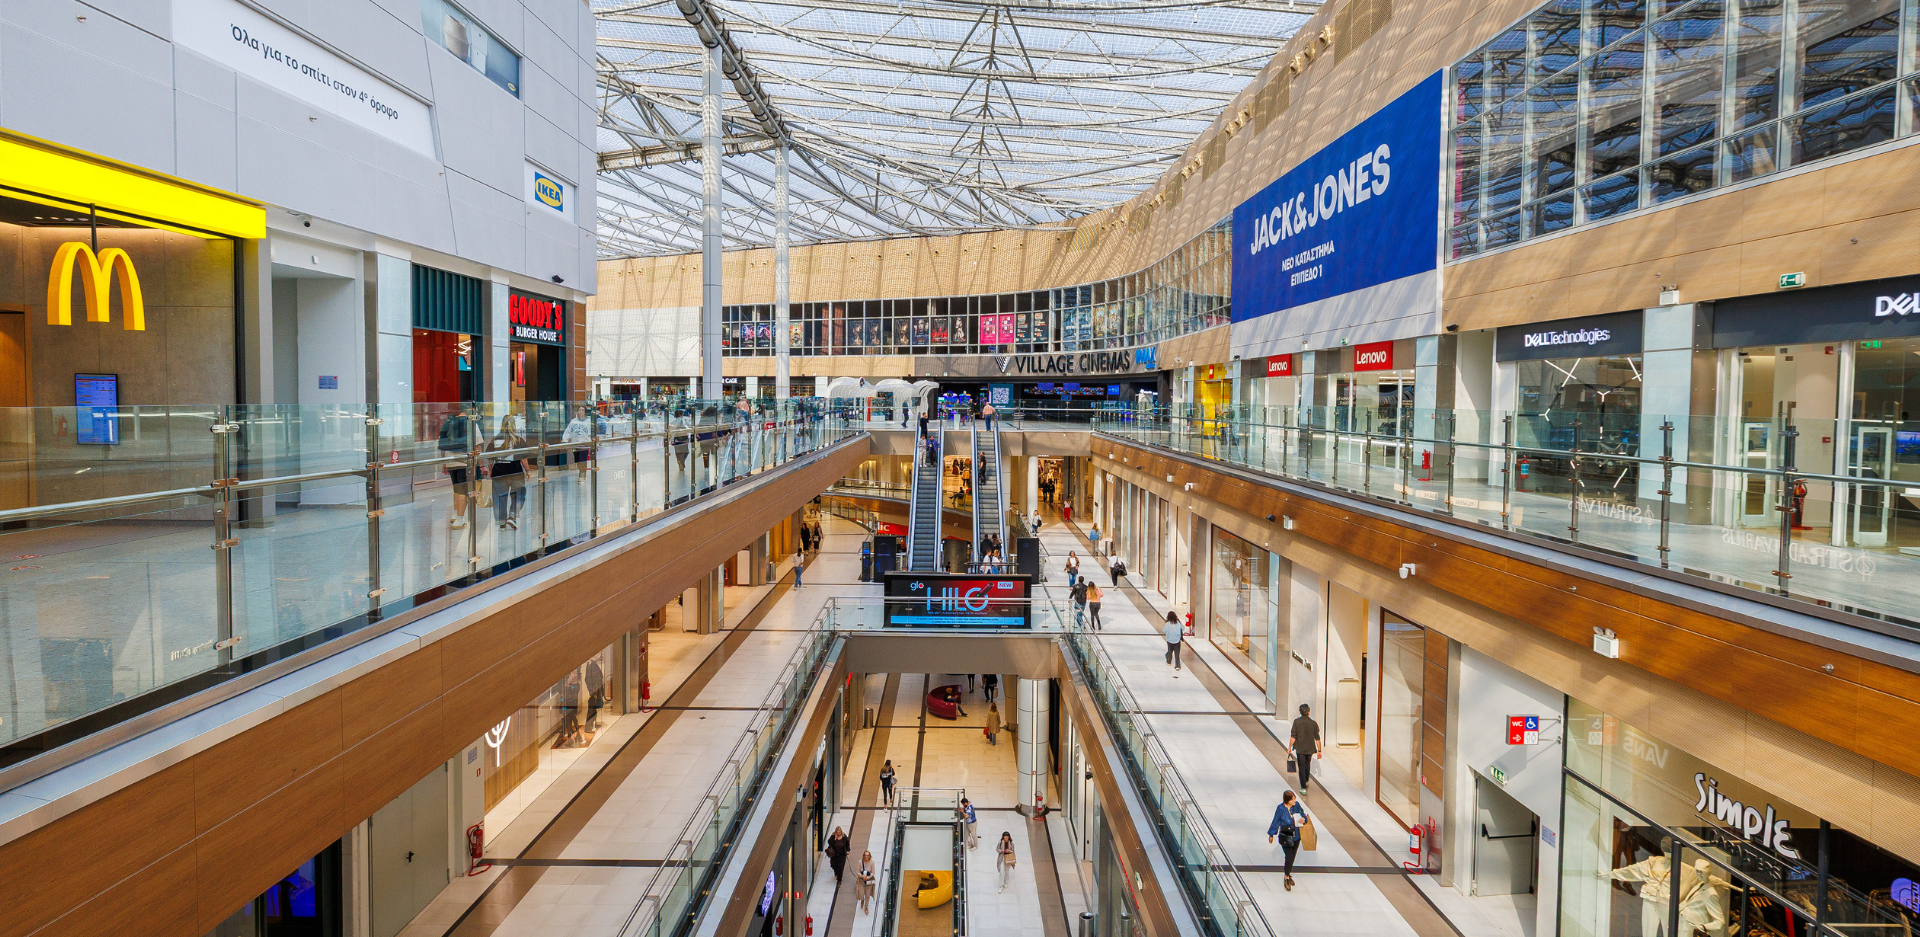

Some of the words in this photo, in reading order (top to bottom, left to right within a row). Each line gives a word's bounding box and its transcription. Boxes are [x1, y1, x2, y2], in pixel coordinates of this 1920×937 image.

[230, 23, 259, 51] Όλα
[262, 43, 282, 62] για
[285, 54, 298, 70] το
[301, 63, 331, 87] σπίτι
[333, 80, 357, 99] στον
[370, 95, 399, 120] όροφο
[537, 181, 562, 203] IKEA
[1251, 143, 1391, 255] JACK&JONES
[1281, 256, 1295, 272] ΝΕΟ
[1294, 240, 1335, 267] ΚΑΤΑΣΤΗΜΑ
[1290, 266, 1318, 287] ΕΠΙΠΕΔΟ
[1318, 264, 1323, 278] 1
[509, 294, 563, 331] GOODY'S
[516, 326, 538, 339] BURGER
[538, 329, 557, 342] HOUSE
[1015, 354, 1074, 374] VILLAGE
[1080, 350, 1130, 373] CINEMAS
[1268, 360, 1288, 372] Lenovo
[1356, 350, 1387, 365] Lenovo
[910, 580, 924, 591] glo
[926, 587, 989, 612] HILO
[1694, 772, 1800, 860] Simple
